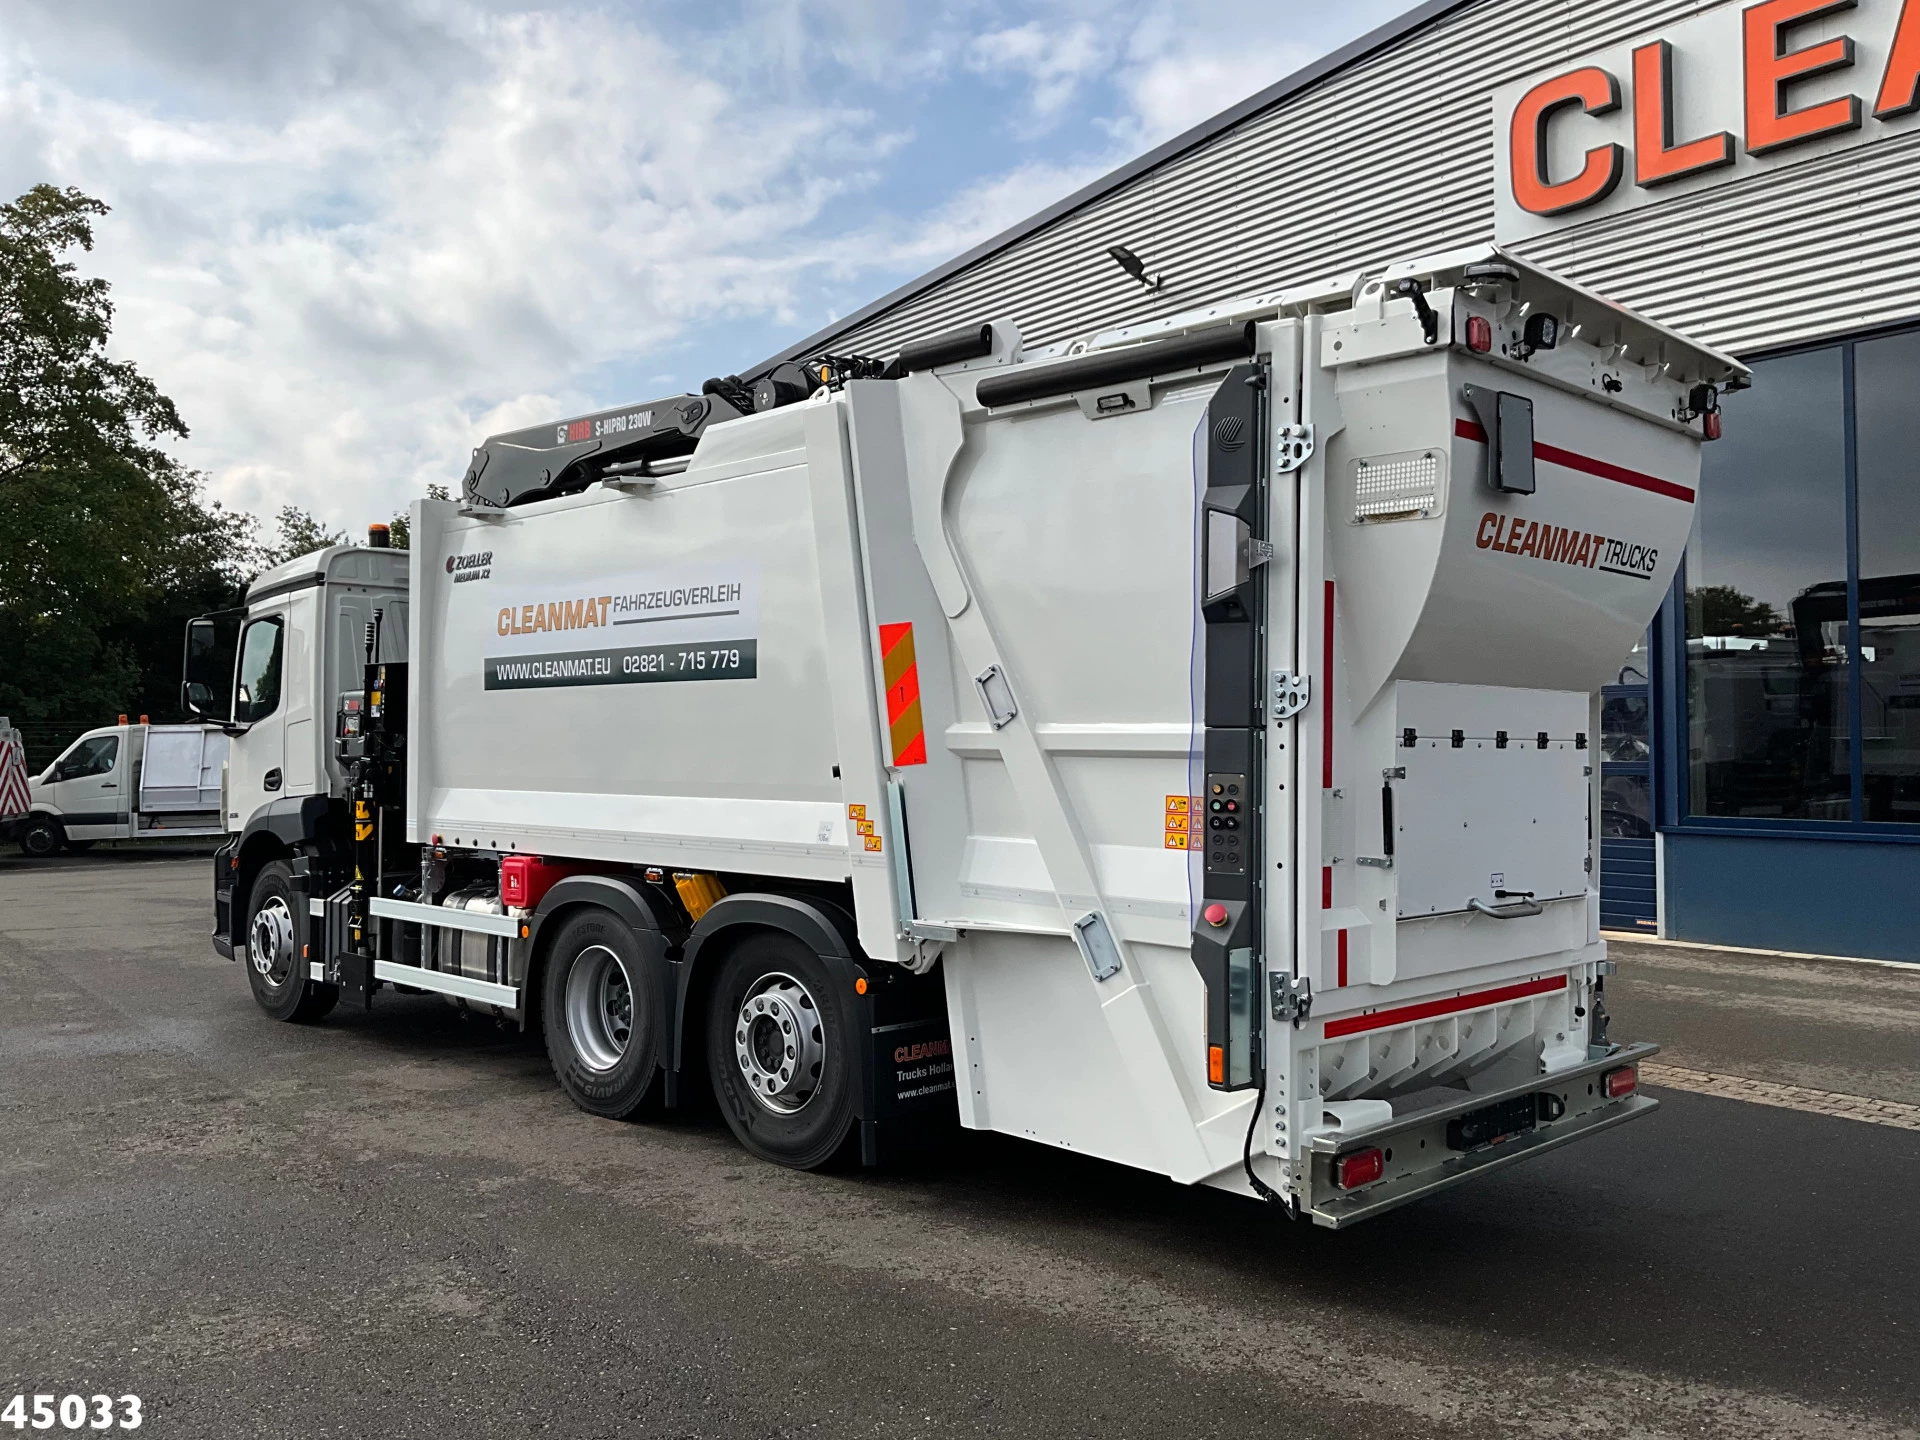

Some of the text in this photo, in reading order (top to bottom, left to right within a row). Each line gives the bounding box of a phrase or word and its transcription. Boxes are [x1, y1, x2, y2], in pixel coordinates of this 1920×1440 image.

[595, 415, 626, 437] S-HIPRO
[628, 410, 652, 430] 230W
[1475, 512, 1658, 572] CLEANMAT TRUCKS
[455, 551, 493, 570] ZOELLER
[497, 583, 741, 636] CLEANMAT FAHRZEUGVERLEIH
[496, 658, 611, 681] WWW.CLEANMAT.EU
[623, 653, 665, 674] 02821
[678, 651, 706, 670] 715
[710, 649, 739, 669] 779
[897, 1067, 927, 1082] Trucks
